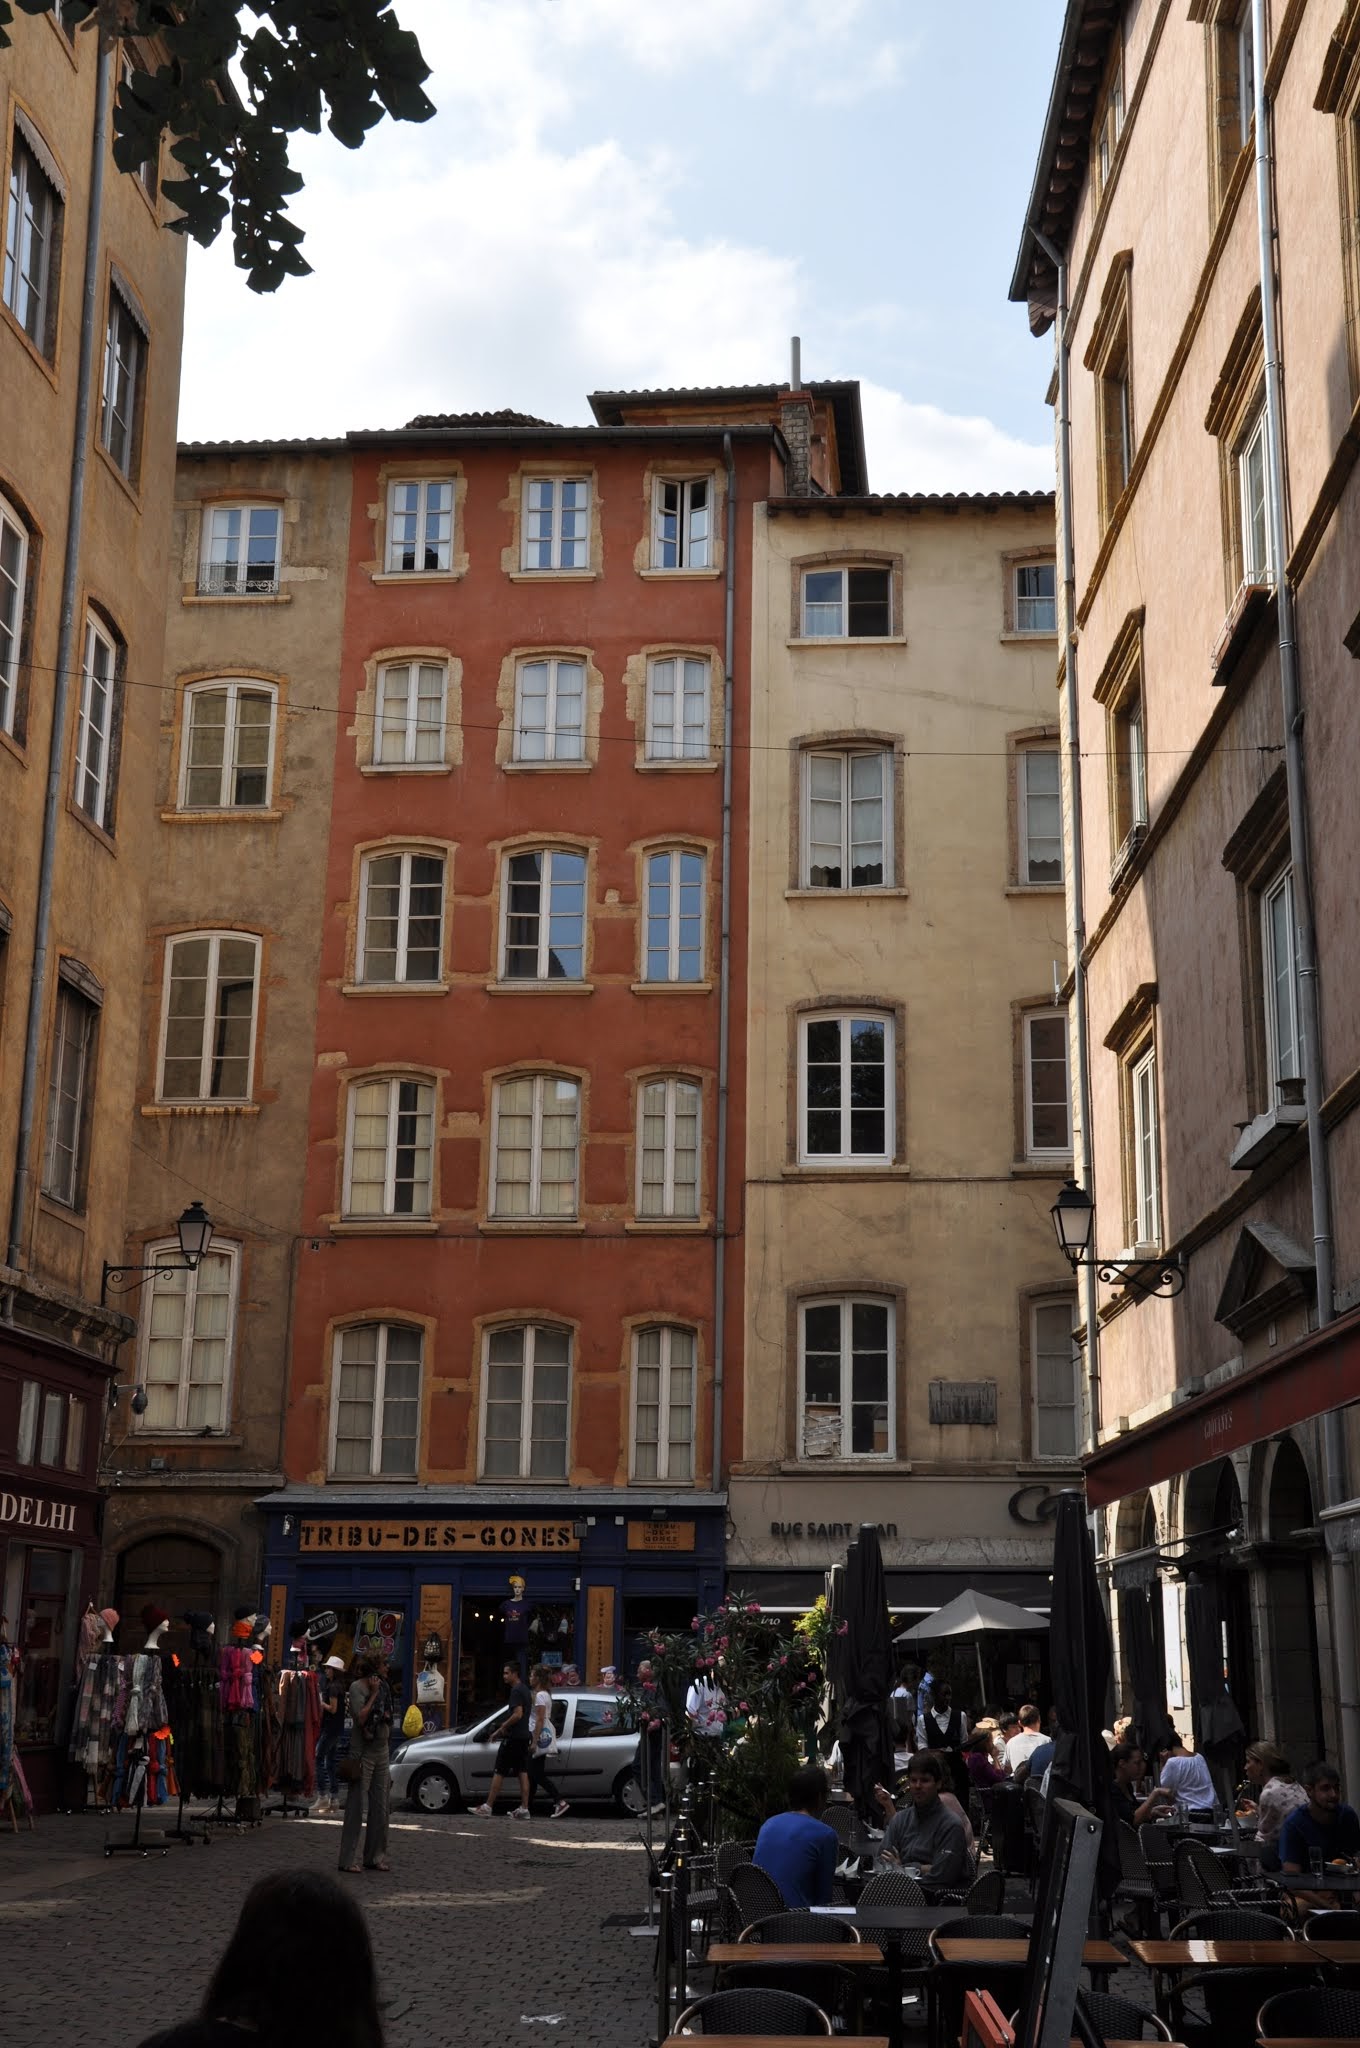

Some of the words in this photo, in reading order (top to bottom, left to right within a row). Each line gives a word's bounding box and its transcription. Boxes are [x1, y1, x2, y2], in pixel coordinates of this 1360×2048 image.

[0, 1492, 77, 1532] DELHI
[301, 1526, 571, 1547] TRIBU-DES-GONES
[770, 1522, 803, 1537] RUE
[807, 1522, 853, 1537] SAINT
